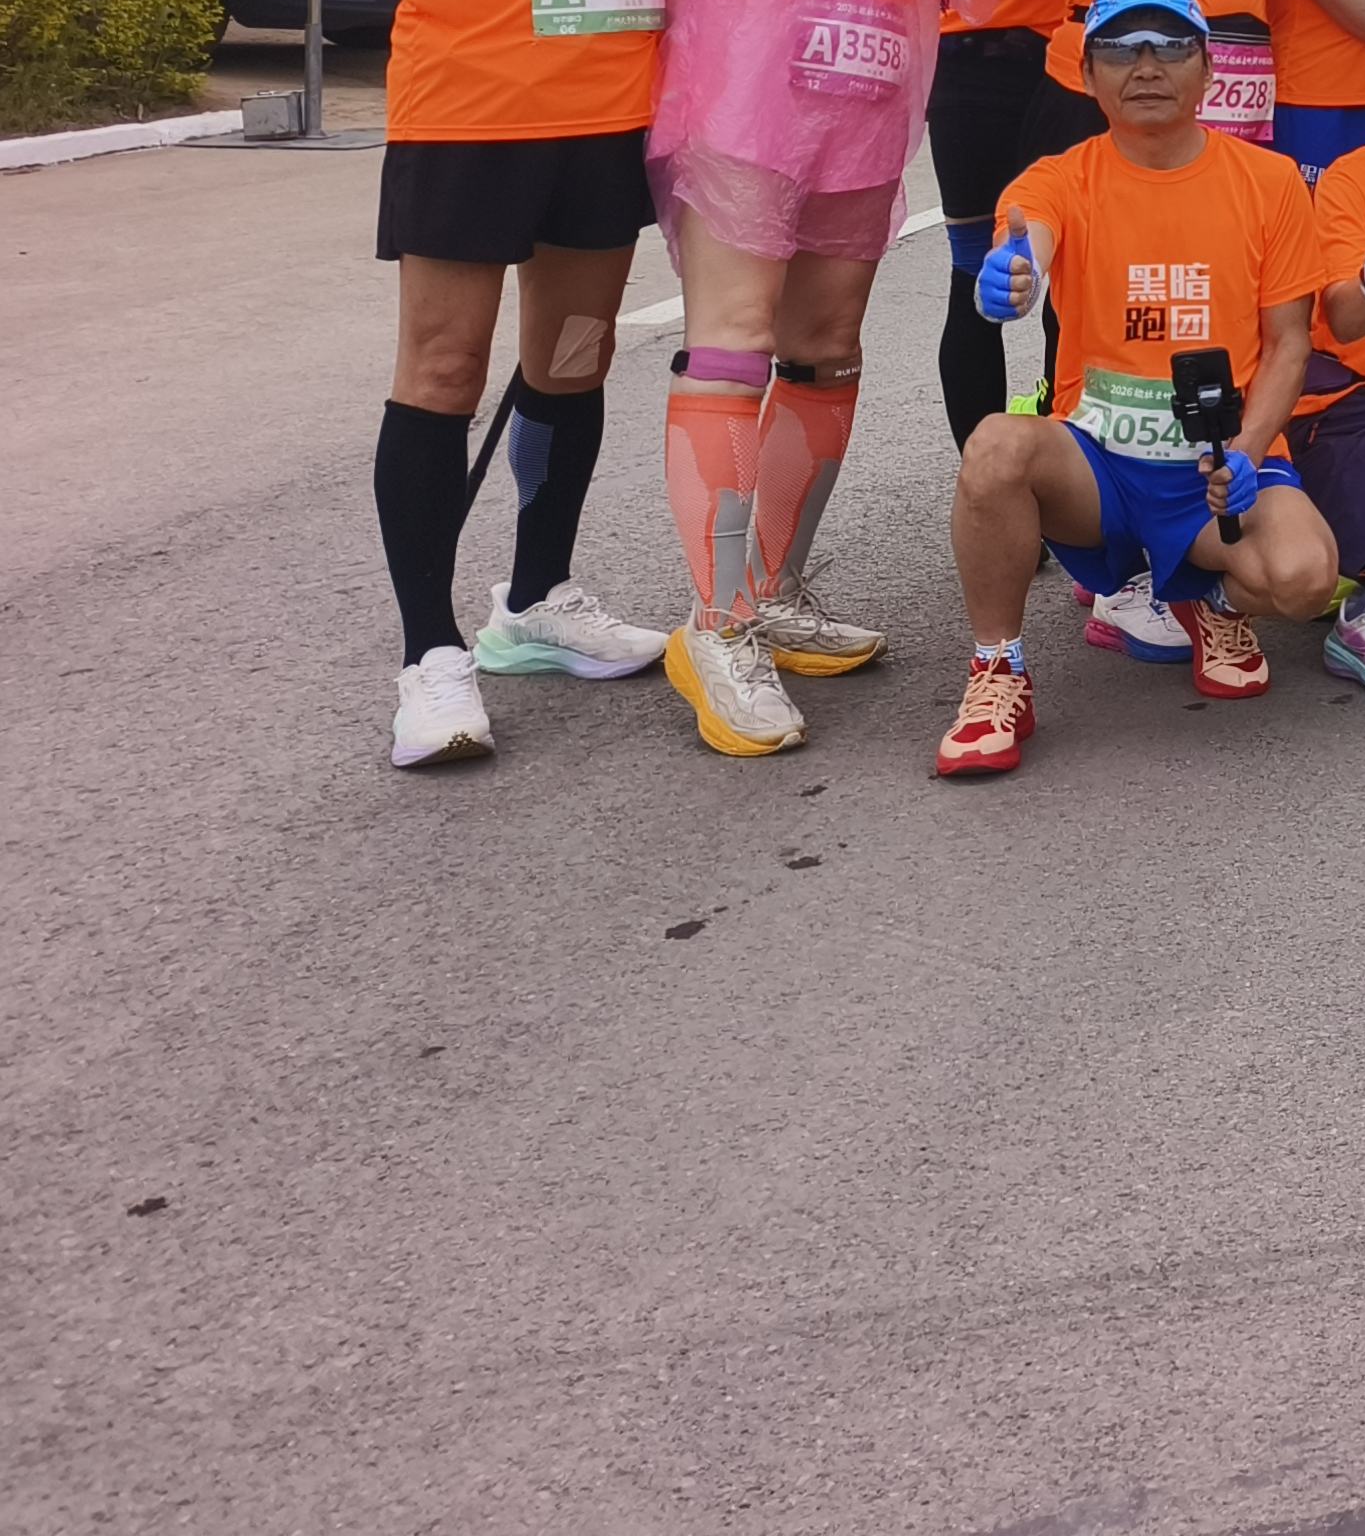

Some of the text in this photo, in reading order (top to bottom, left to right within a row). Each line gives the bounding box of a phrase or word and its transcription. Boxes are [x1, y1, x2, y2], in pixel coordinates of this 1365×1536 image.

[560, 24, 576, 35] 06
[1207, 79, 1269, 110] 2628
[1127, 263, 1211, 303] 黑暗
[1124, 305, 1210, 342] 跑团
